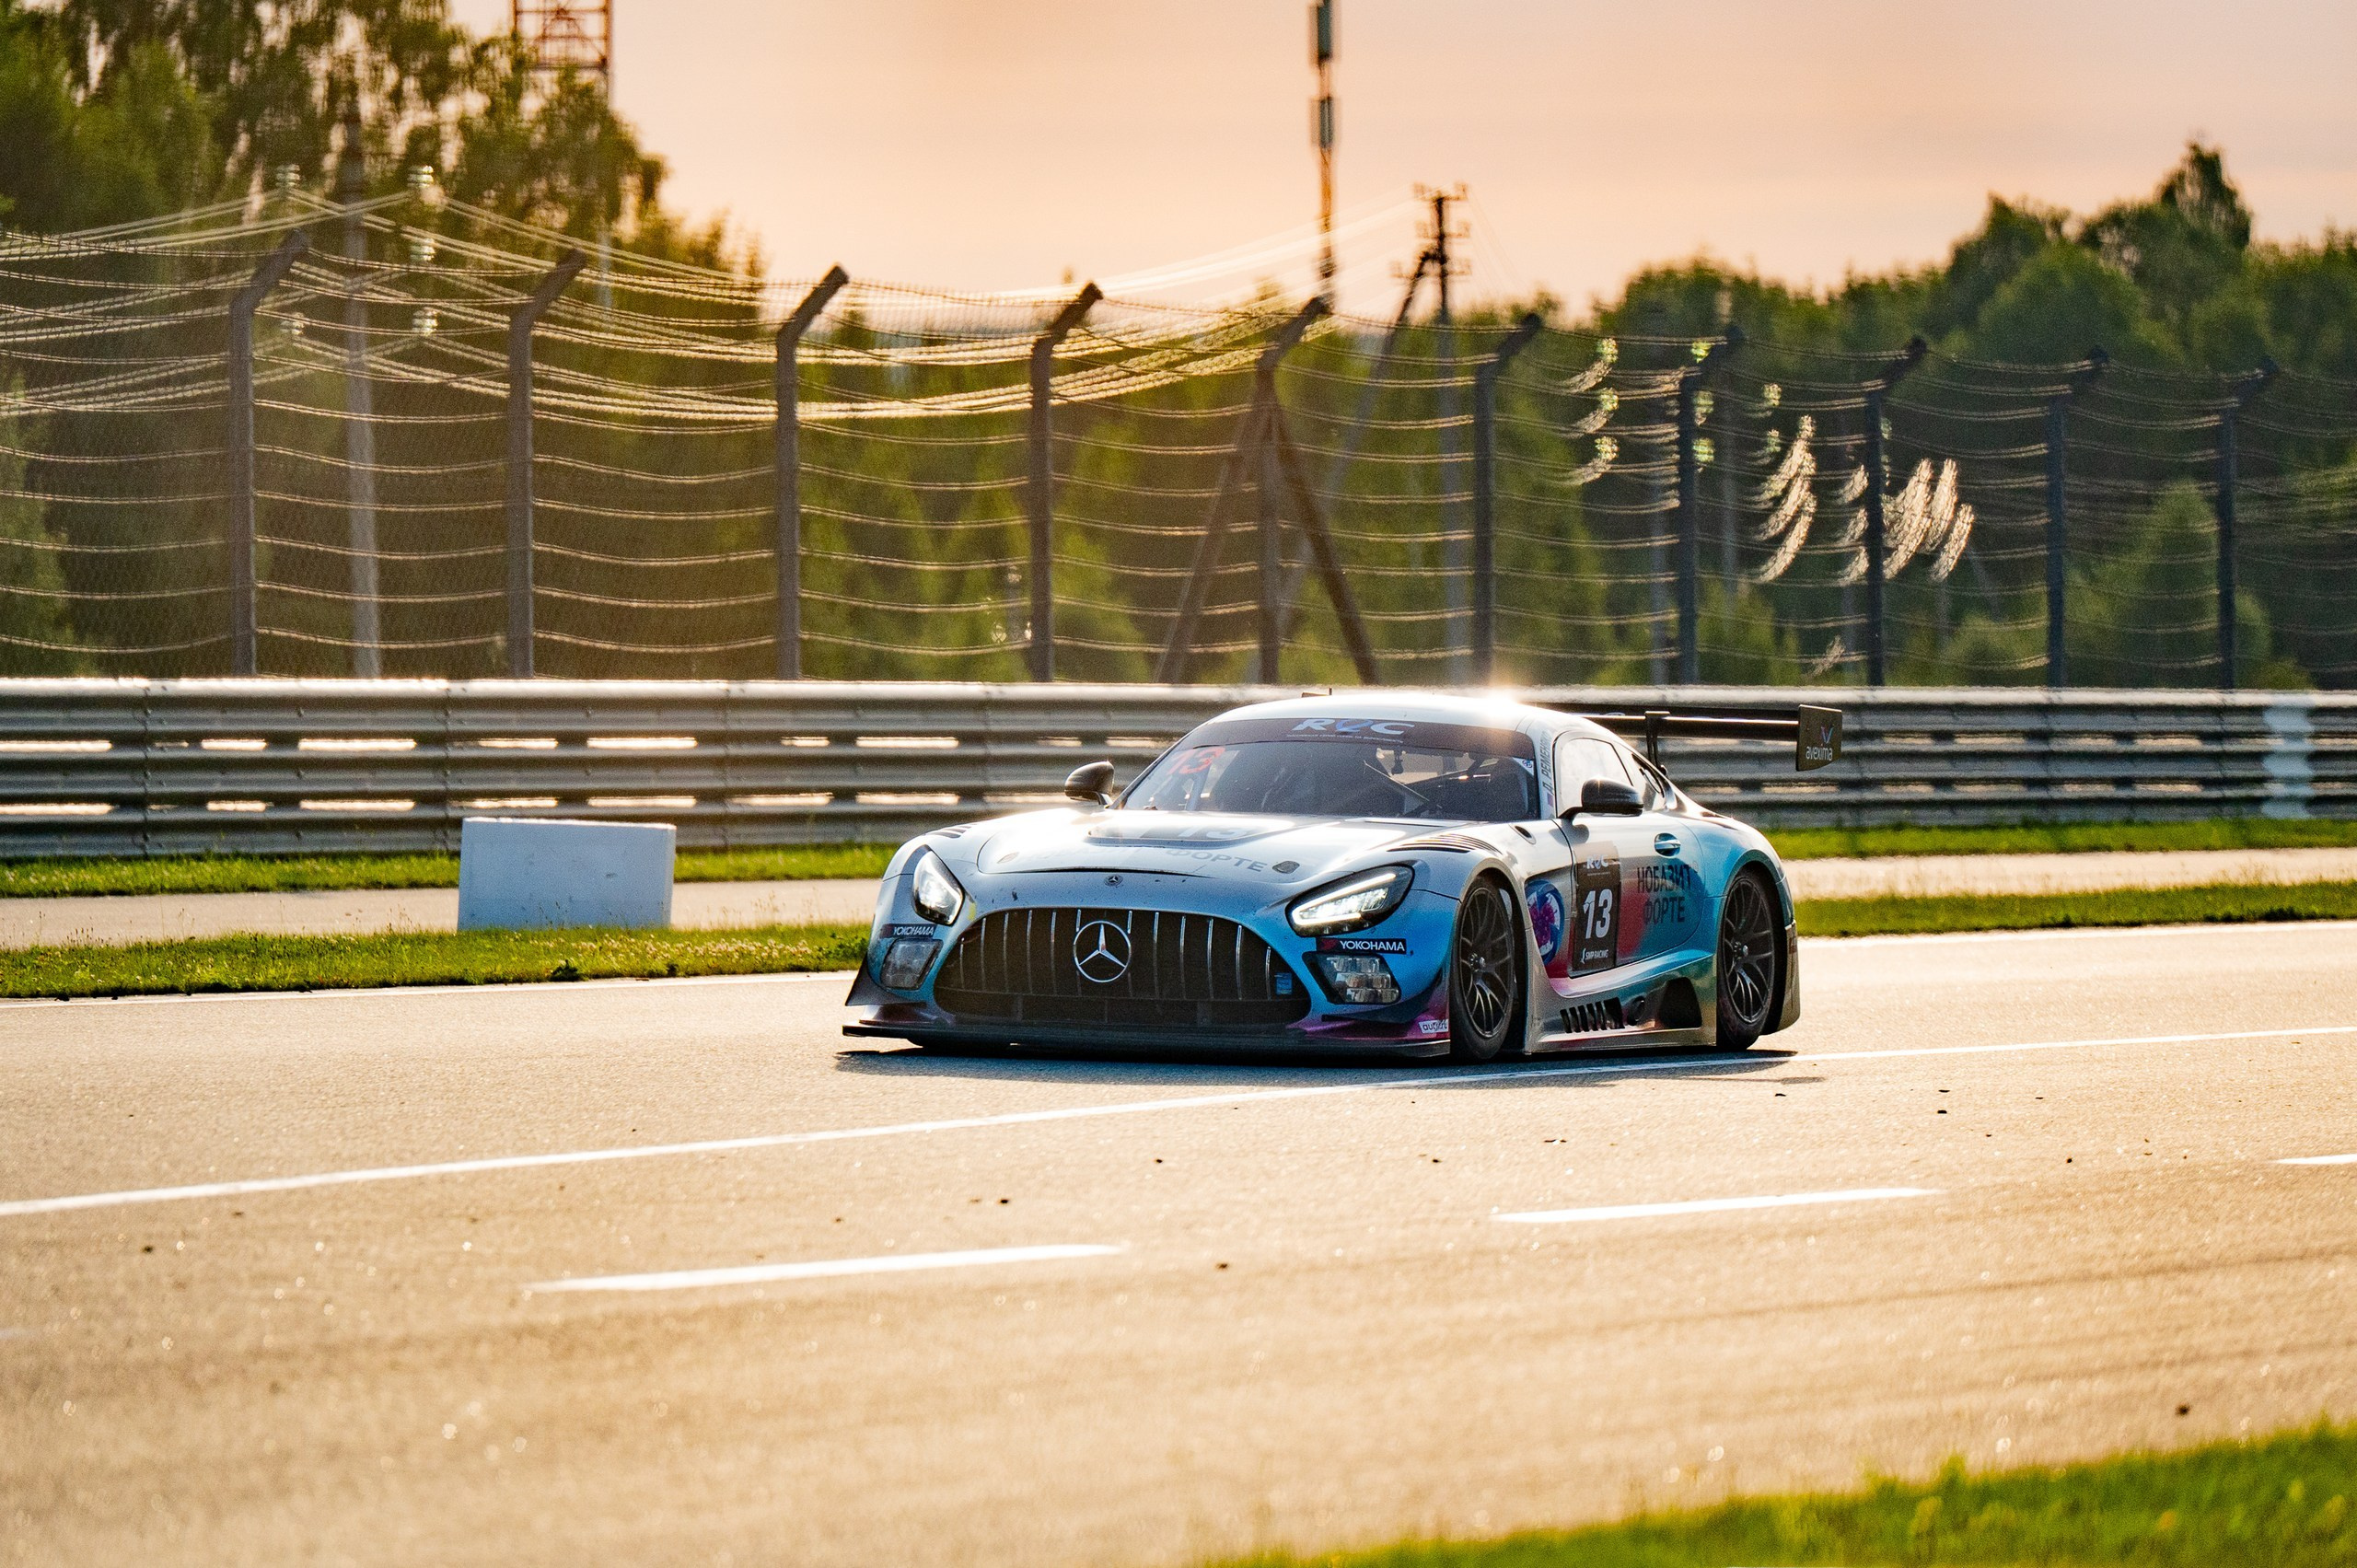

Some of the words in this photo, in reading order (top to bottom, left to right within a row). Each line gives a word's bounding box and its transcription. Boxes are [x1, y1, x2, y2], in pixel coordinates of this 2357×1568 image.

[1583, 889, 1613, 939] 13
[1643, 896, 1685, 924] ФОРТЕ
[893, 926, 935, 935] YOKOHAMA
[1340, 940, 1405, 952] YOKOHAMA
